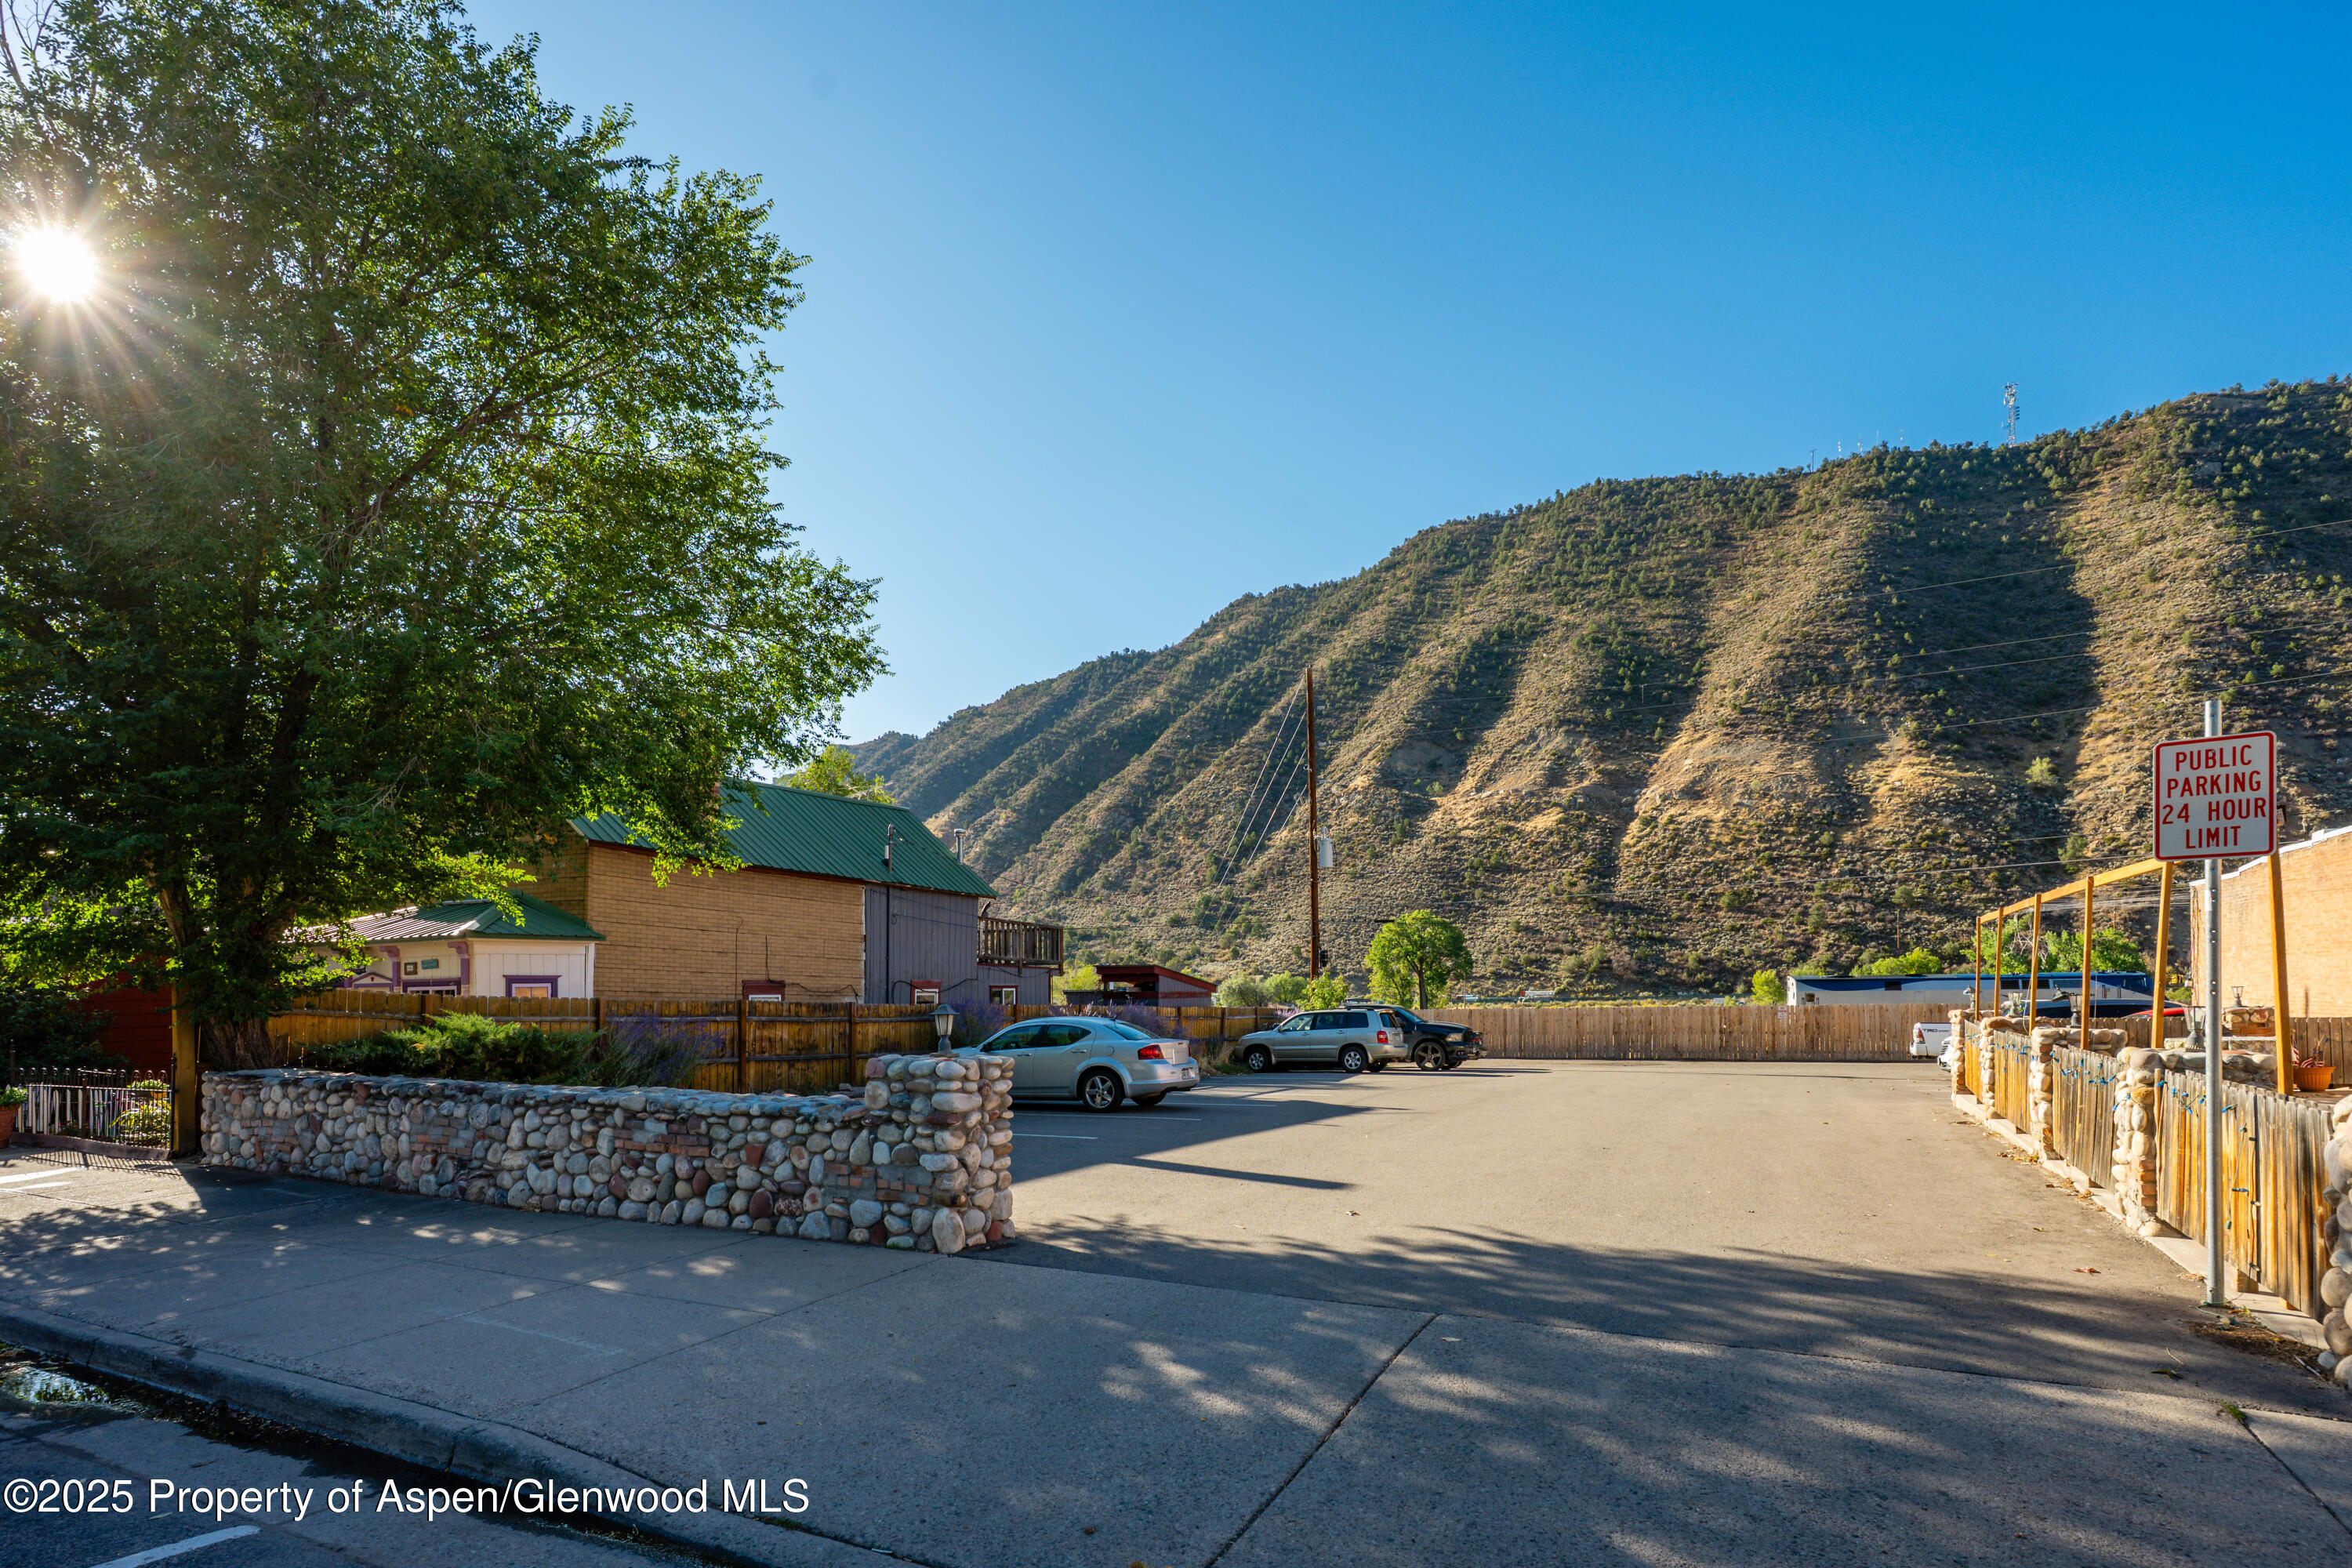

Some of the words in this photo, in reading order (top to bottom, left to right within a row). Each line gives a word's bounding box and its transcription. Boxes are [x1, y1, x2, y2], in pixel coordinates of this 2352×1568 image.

[2176, 745, 2252, 772] PUBLIC
[2167, 770, 2262, 798] PARKING
[2162, 803, 2190, 824] 24
[2209, 797, 2267, 821] HOUR
[2186, 826, 2241, 849] LIMIT
